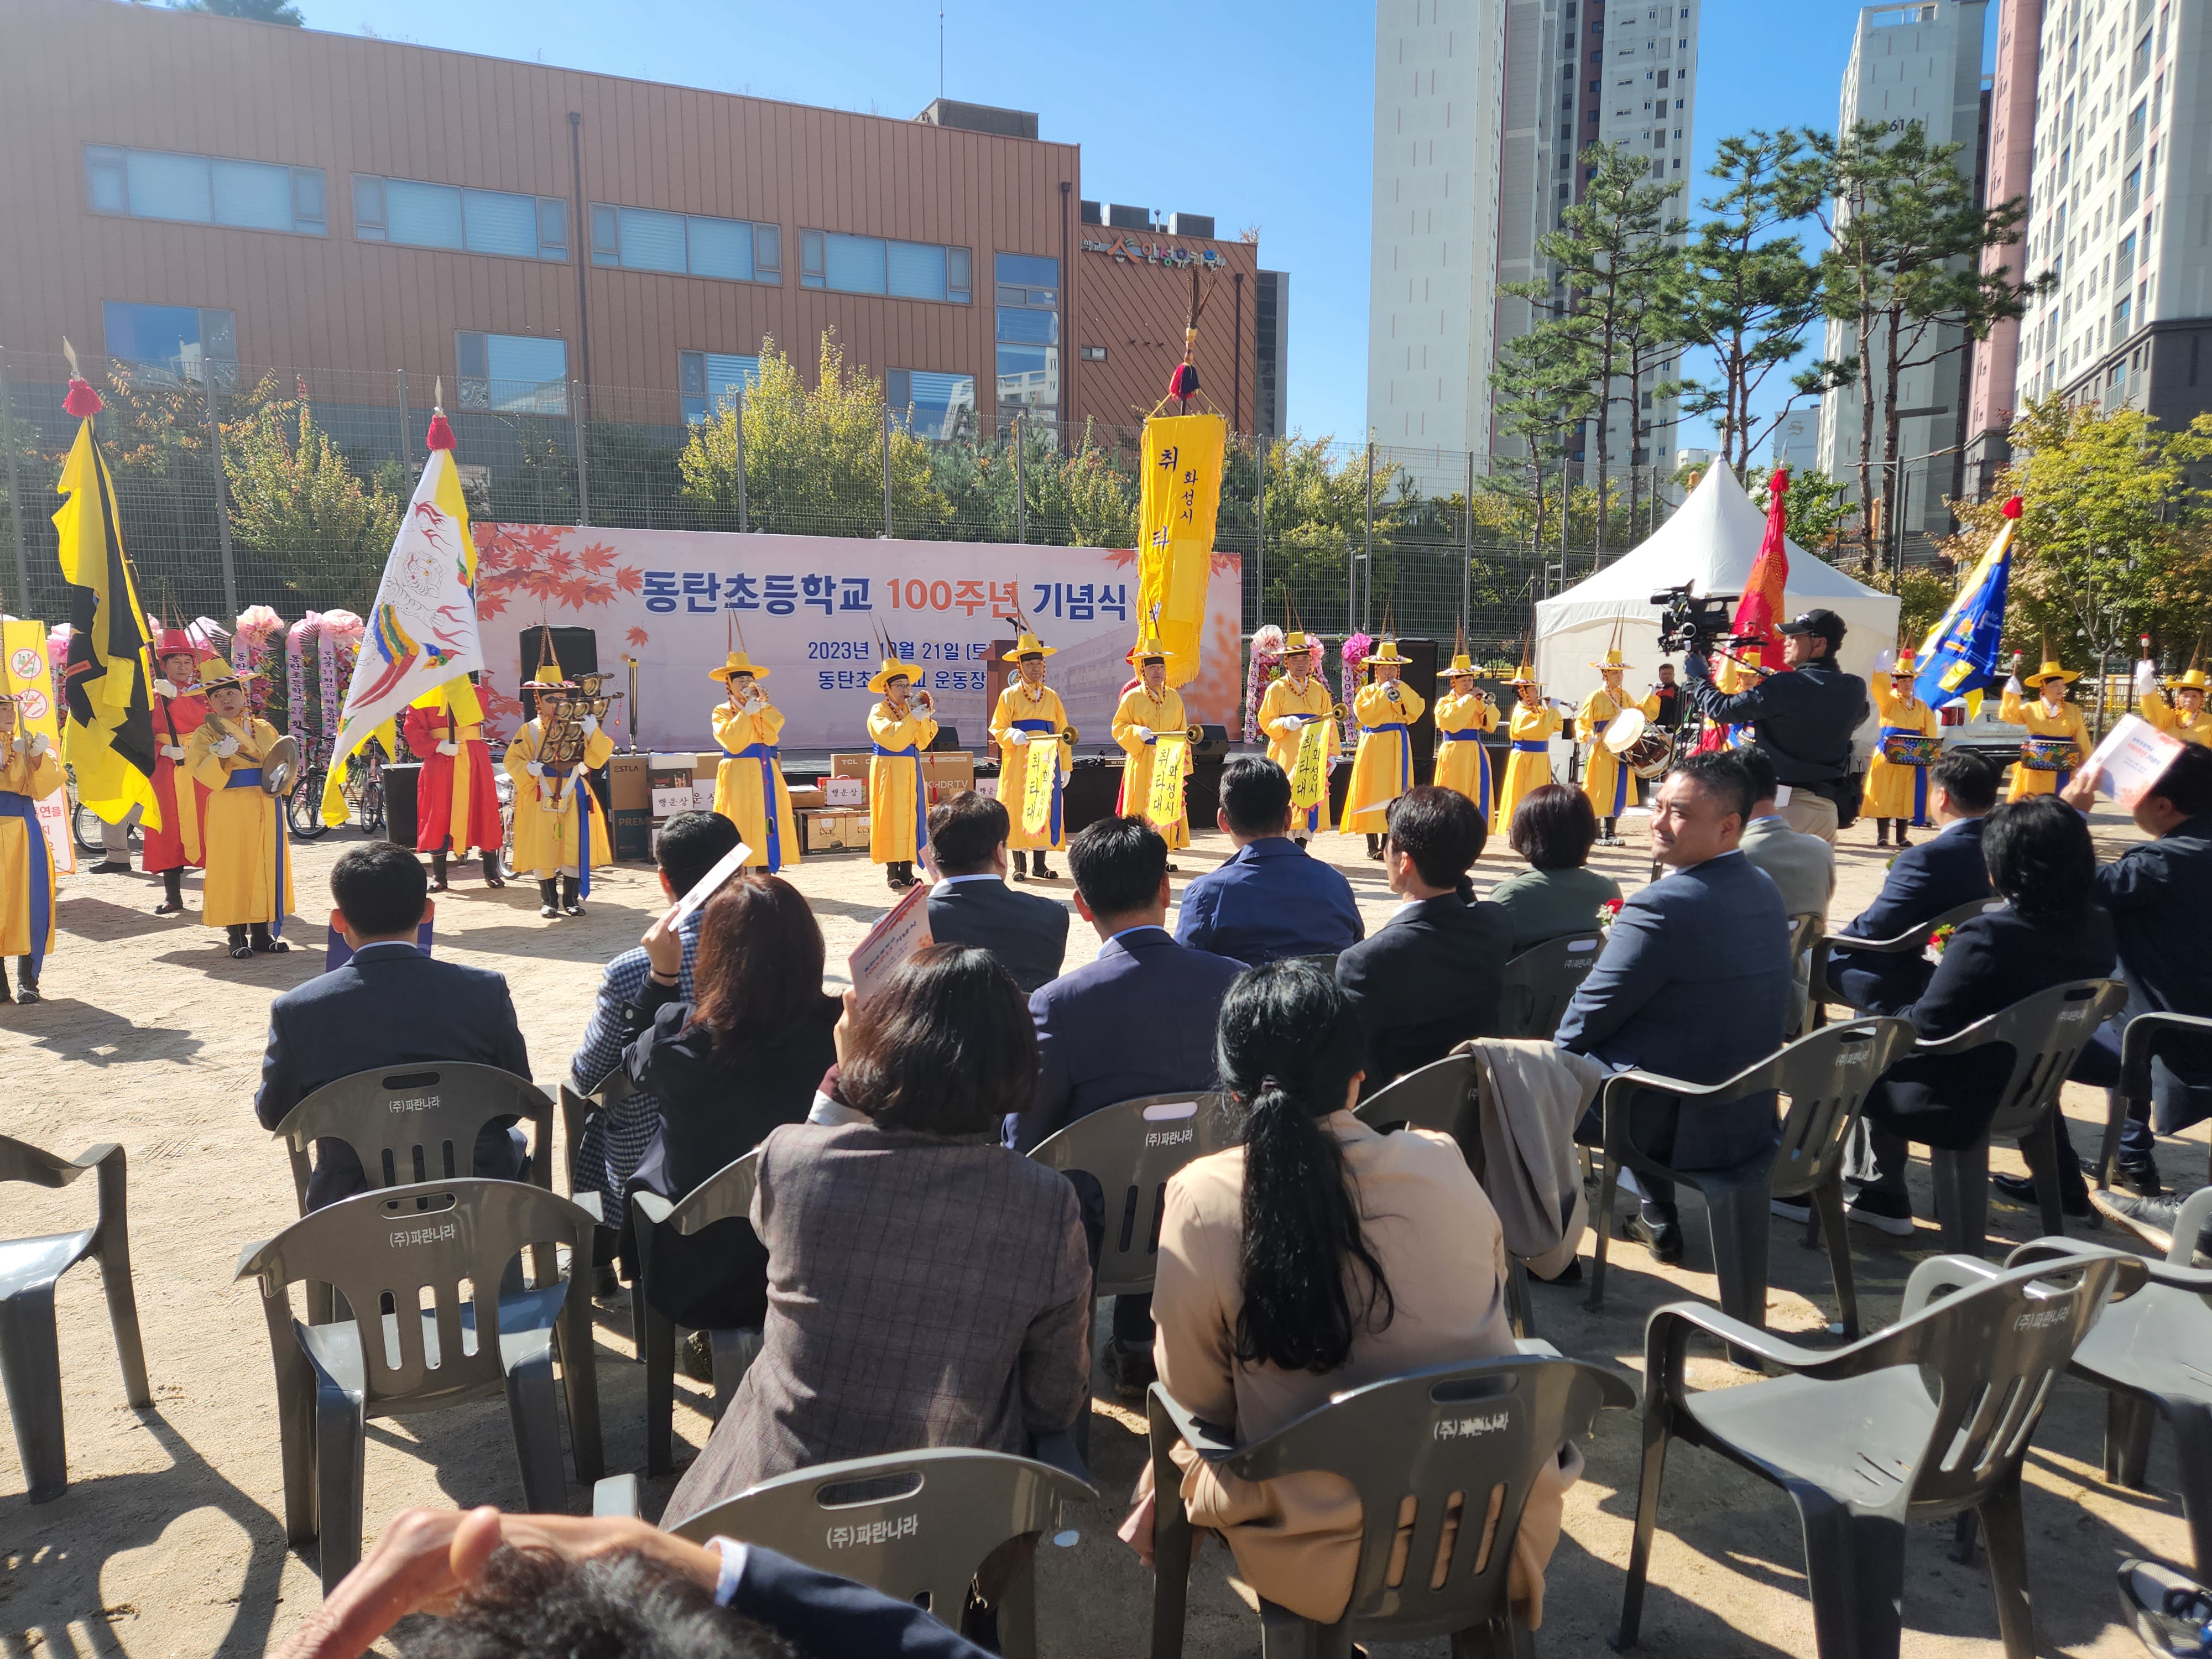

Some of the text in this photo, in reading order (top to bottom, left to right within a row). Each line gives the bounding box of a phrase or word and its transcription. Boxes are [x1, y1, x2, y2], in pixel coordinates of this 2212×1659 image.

[1180, 468, 1198, 526] 화성시
[643, 571, 1126, 621] 동탄초등학교 100주년 기념식
[808, 641, 869, 660] 2023년
[923, 643, 959, 660] 21일
[288, 655, 303, 702] 동탄초등학교
[935, 671, 986, 690] 운동장
[1154, 748, 1170, 817] 취타대
[1297, 733, 1313, 800] 취타대
[1308, 748, 1322, 798] 화성시
[658, 797, 688, 807] 행운상
[831, 788, 858, 797] 행운상
[1027, 752, 1040, 823] 취타대
[1036, 769, 1050, 822] 화성시
[1165, 765, 1178, 817] 화성시
[389, 1095, 441, 1113] (주)파란나라
[1146, 1128, 1193, 1147] (주)파란나라
[389, 1223, 455, 1248] (주)파란나라
[2013, 1305, 2071, 1332] (주)파란나라
[826, 1514, 919, 1550] (주)파란나라
